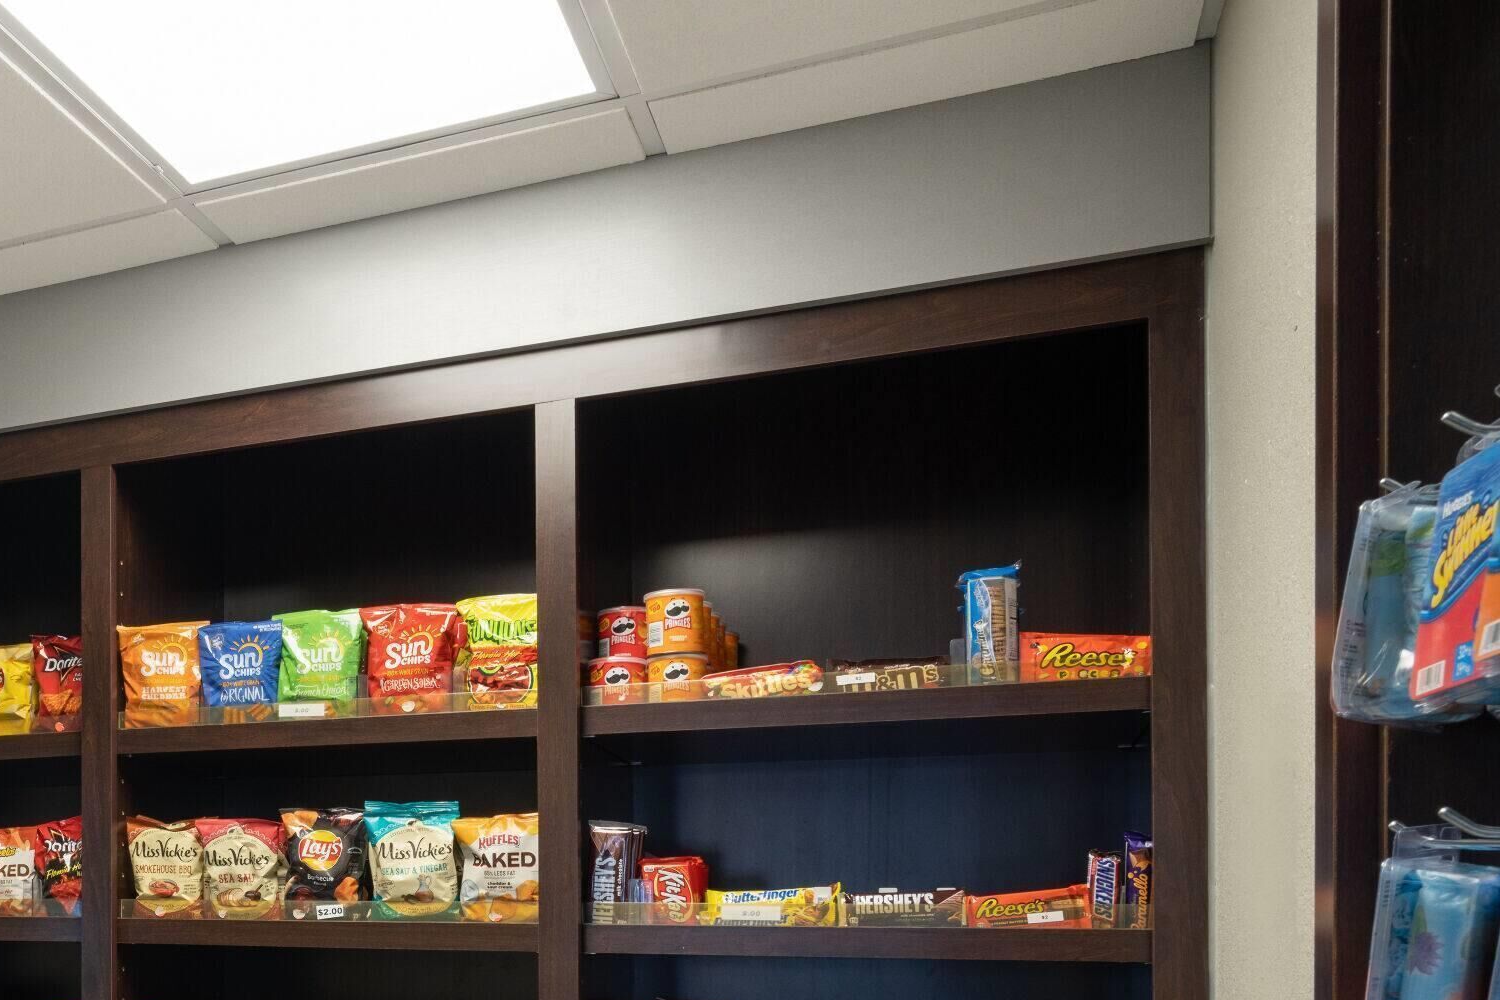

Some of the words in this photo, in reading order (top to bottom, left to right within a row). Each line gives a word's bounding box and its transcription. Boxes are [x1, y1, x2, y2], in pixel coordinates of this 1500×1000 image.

[467, 618, 537, 642] FUNYUNS
[664, 618, 691, 629] PRINGLES
[612, 635, 635, 645] PRINGLES
[296, 646, 338, 675] Sun
[385, 639, 428, 669] Sun
[401, 655, 431, 665] CHIPS
[1041, 643, 1137, 669] Reese's
[219, 652, 258, 680] Sun
[234, 668, 261, 678] CHIPS
[309, 661, 342, 673] CHIPS
[142, 686, 187, 694] HARVEST
[605, 685, 629, 696] PRINGLES
[664, 681, 690, 690] PRINGLES
[721, 674, 815, 698] Skittles
[221, 686, 269, 703] ORIGINAL
[132, 842, 160, 859] Miss
[157, 837, 198, 862] Vickie's
[301, 837, 342, 861] Lay's
[378, 842, 411, 861] Miss
[407, 837, 453, 861] Vickie's
[478, 834, 519, 850] RUFFLES
[204, 850, 233, 866] Miss
[229, 846, 271, 870] Vickie's
[472, 852, 536, 868] BAKED
[135, 864, 177, 874] SMOKEHOUSE
[178, 865, 193, 876] BBQ
[382, 867, 395, 876] SEA
[419, 862, 448, 873] VINEGAR
[218, 874, 234, 884] SEA
[237, 872, 256, 884] SALT
[307, 874, 334, 882] Barbecue
[592, 857, 616, 924] HERSHEY'S
[723, 888, 800, 905] Butterfinger
[1095, 857, 1115, 921] SNICKERS
[317, 907, 343, 916] $2.00
[855, 893, 934, 914] HERSHEY'S
[977, 899, 1045, 918] Reese's
